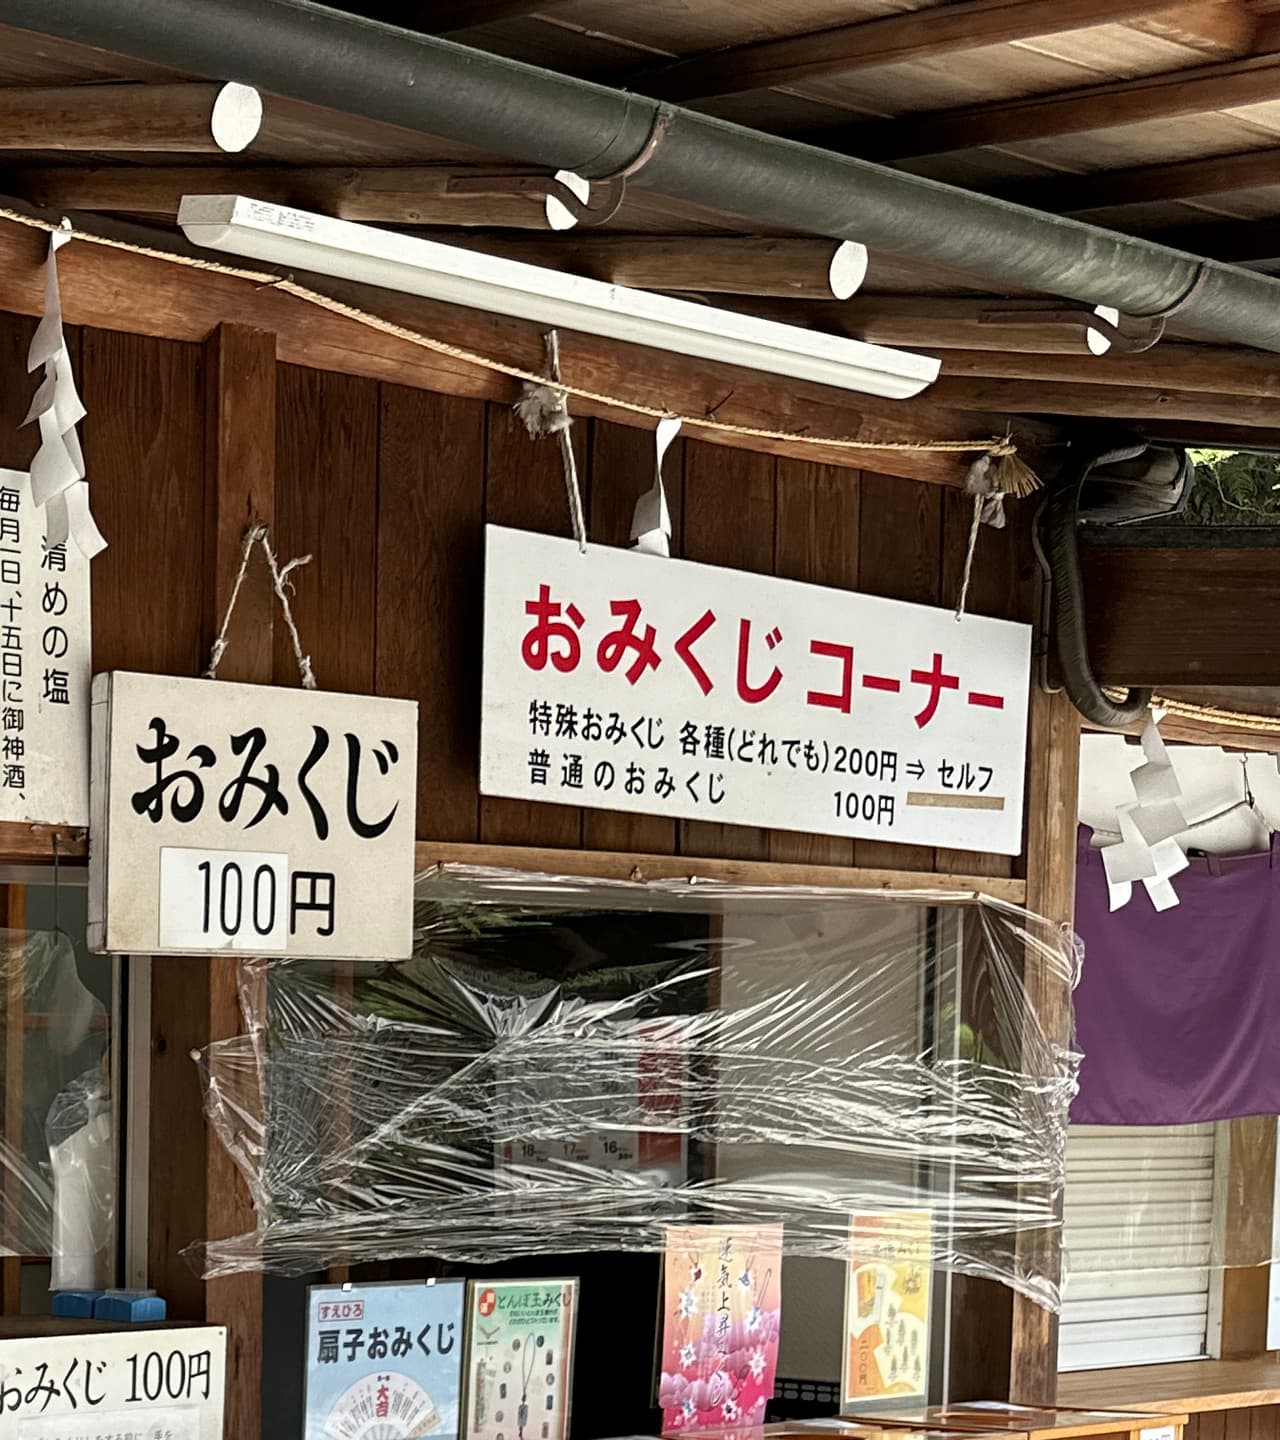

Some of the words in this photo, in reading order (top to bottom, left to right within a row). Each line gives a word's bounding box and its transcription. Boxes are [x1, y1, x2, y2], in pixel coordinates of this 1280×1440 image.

[0, 487, 26, 801] 毎月一日、十五日に御神酒、
[131, 717, 399, 840] おみくじ
[529, 700, 665, 751] 特殊おみくじ
[937, 758, 995, 793] セルフ
[528, 749, 727, 804] 普通のおみくじ
[834, 790, 895, 827] 100円
[198, 861, 336, 937] 100円
[317, 1322, 455, 1364] 扇子おみくじ
[320, 1303, 363, 1319] すえひろ
[124, 1350, 212, 1402] 100円
[375, 1384, 389, 1418] 大吉
